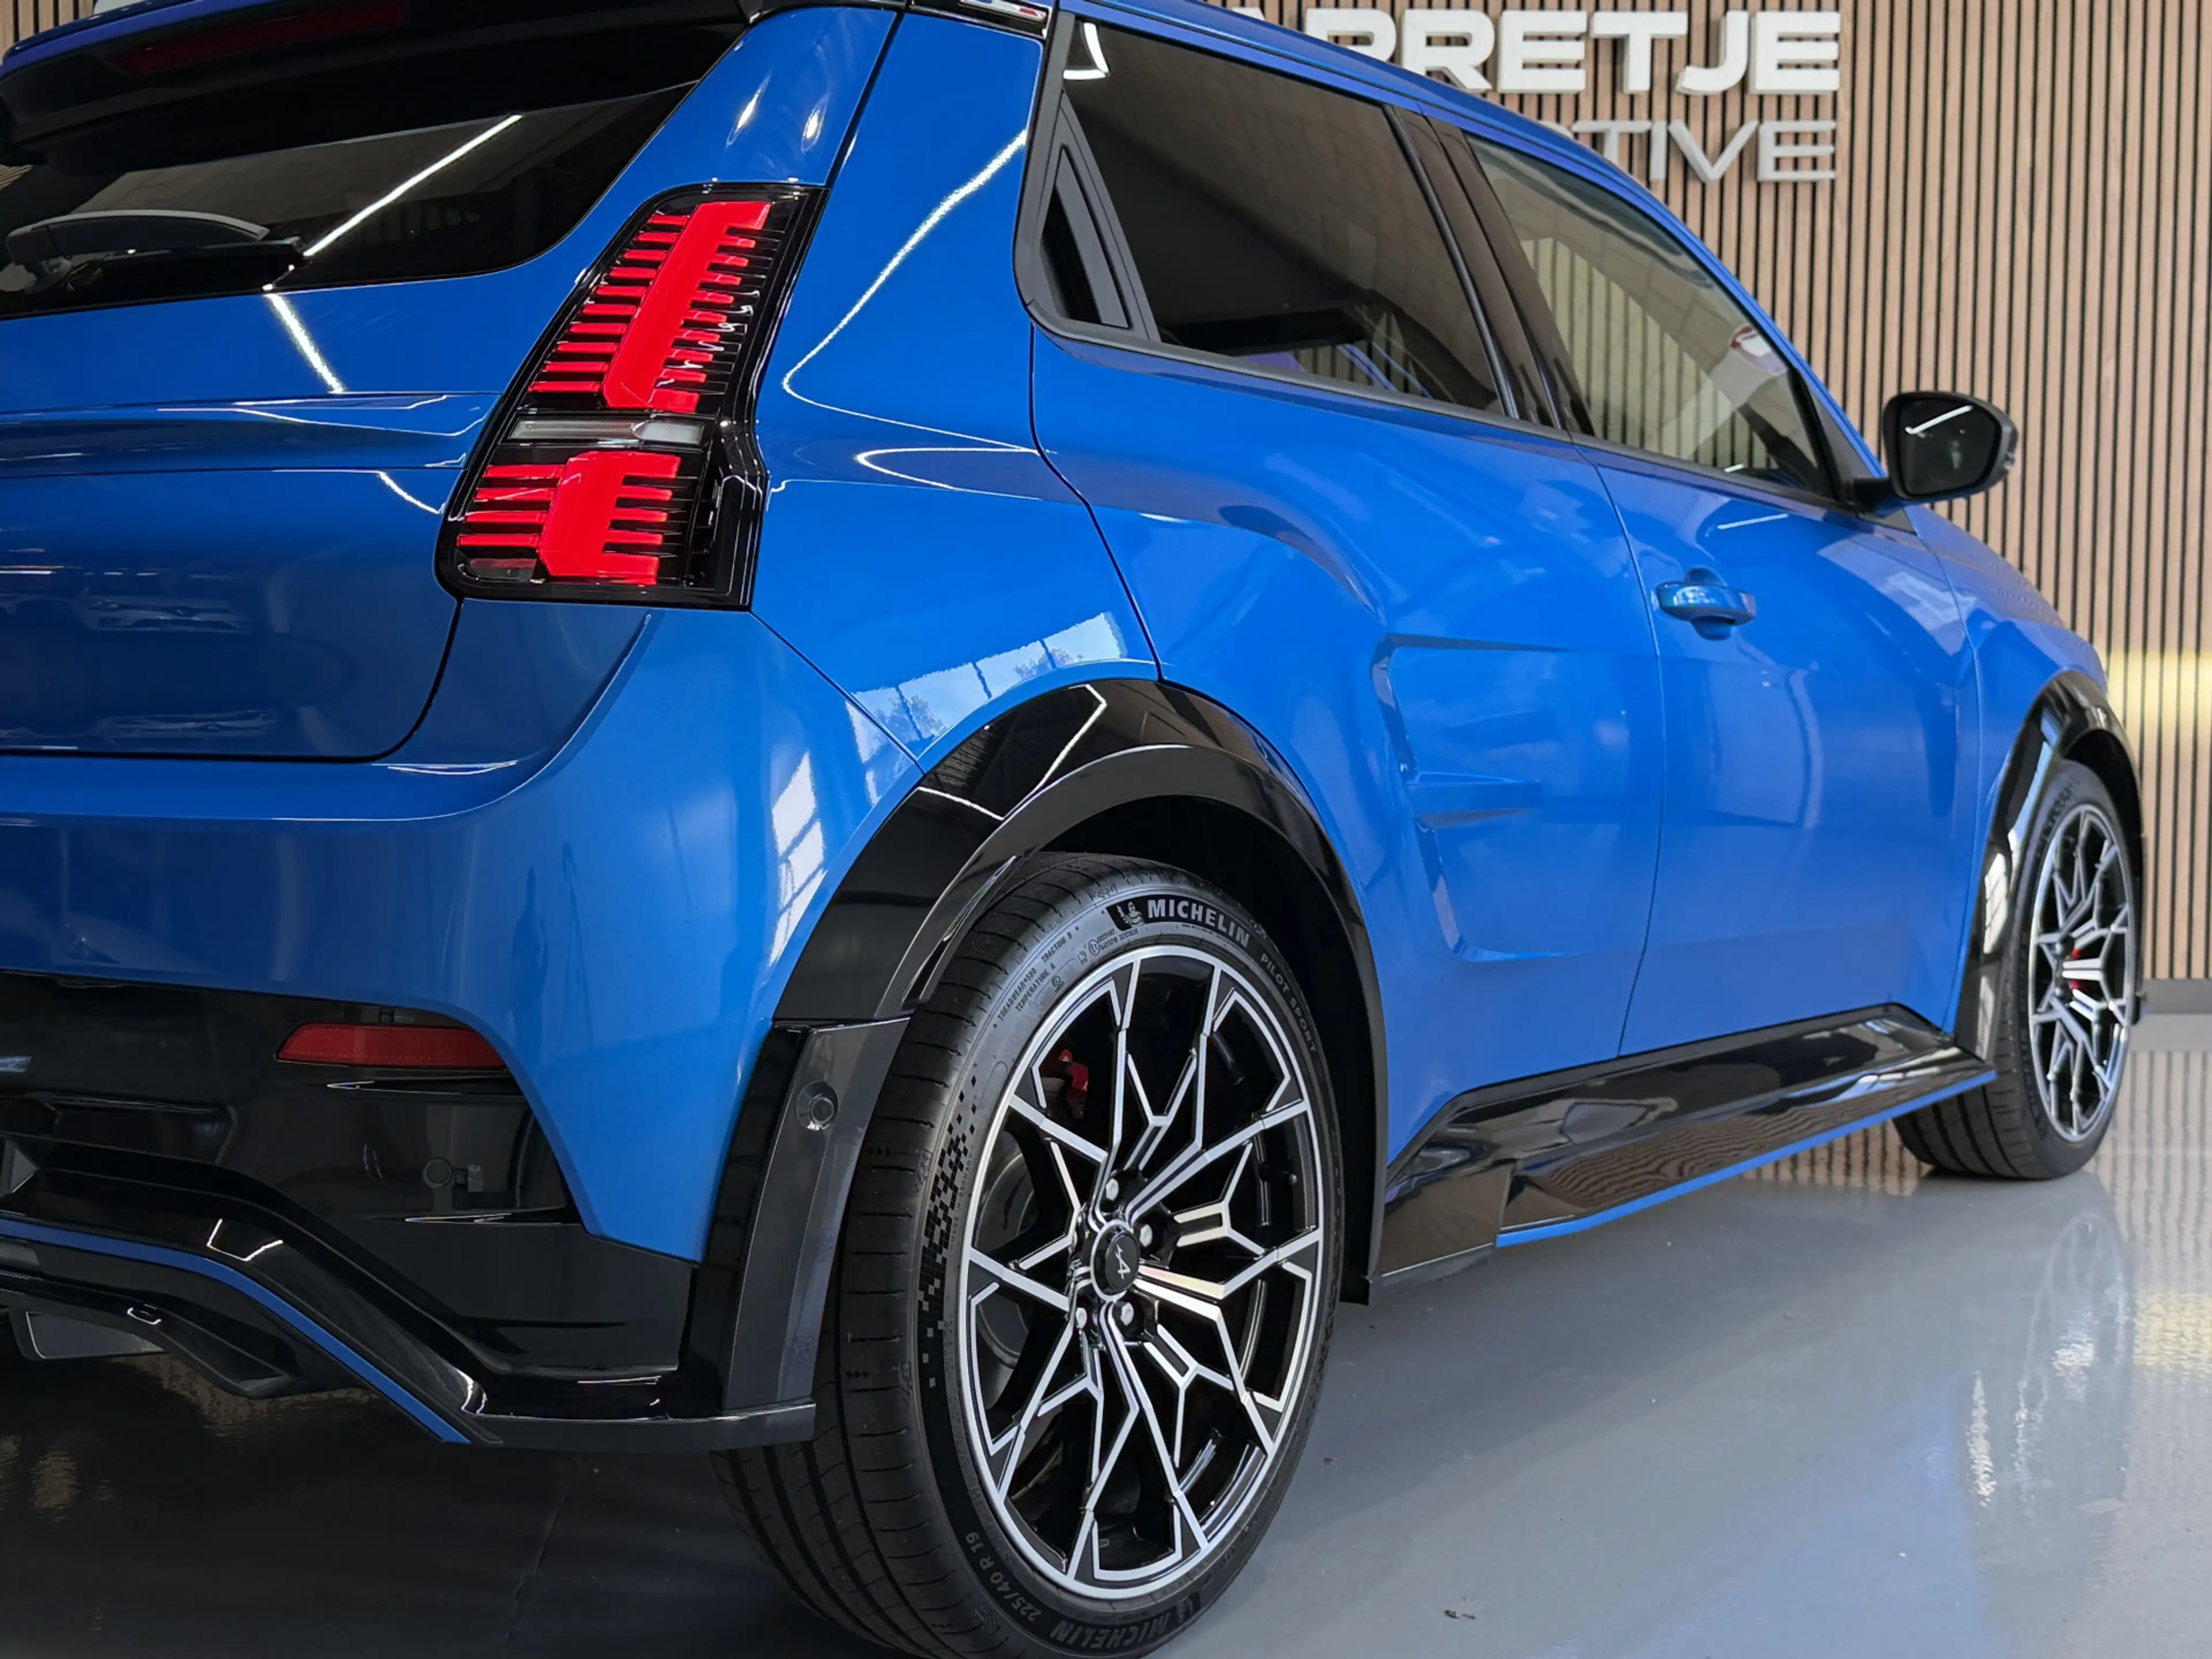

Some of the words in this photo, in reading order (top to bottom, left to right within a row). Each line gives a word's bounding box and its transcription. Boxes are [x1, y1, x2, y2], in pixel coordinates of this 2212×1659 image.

[1232, 7, 1841, 94] RETJE
[1539, 120, 1836, 181] TIVE
[1014, 967, 1050, 1011] TEMPERATURE
[1147, 899, 1251, 948] MICHELIN
[1260, 953, 1290, 993] PILOT
[1289, 997, 1317, 1052] SPORT
[965, 1532, 984, 1553] 19
[980, 1555, 994, 1572] R
[990, 1571, 1042, 1622] 225/40
[1049, 1613, 1170, 1649] MICHELIN
